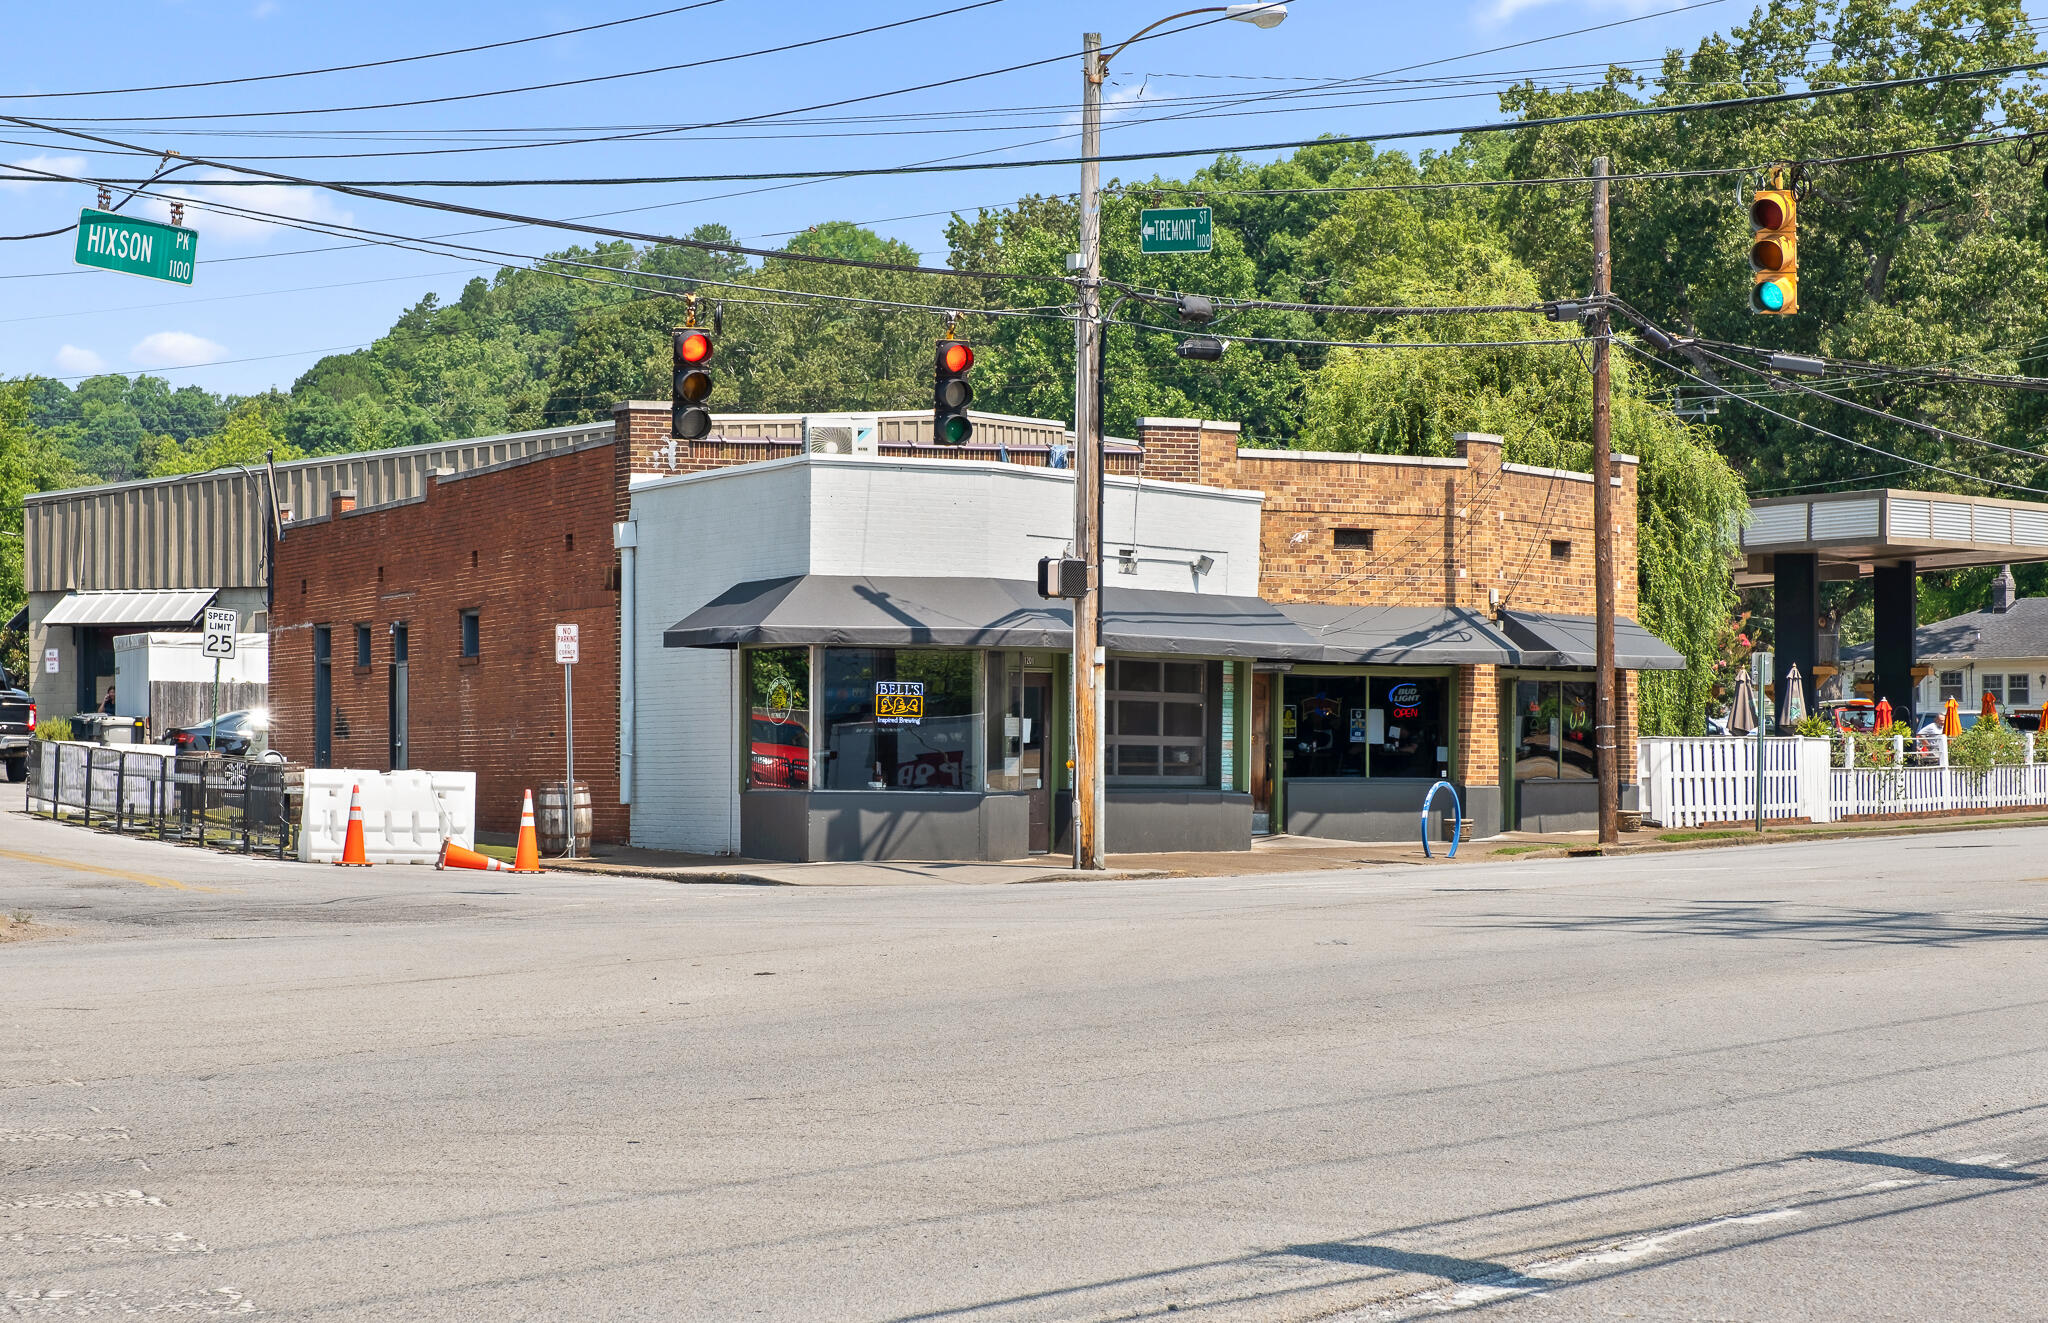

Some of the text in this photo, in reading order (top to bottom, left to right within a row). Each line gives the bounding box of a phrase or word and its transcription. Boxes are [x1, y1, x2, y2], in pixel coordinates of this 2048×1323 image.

[1199, 210, 1207, 224] ST
[1154, 219, 1196, 241] TREMONT
[87, 224, 153, 263] HIXSON
[176, 232, 190, 250] PK
[1197, 233, 1210, 248] 1100
[169, 260, 190, 280] 1100
[208, 611, 235, 622] SPEED
[209, 622, 231, 632] LIMIT
[562, 627, 572, 635] NO
[207, 634, 232, 653] 25
[557, 635, 577, 643] PARKING
[880, 683, 921, 696] BELL'S
[1394, 694, 1420, 702] LIGHT
[1393, 708, 1418, 718] OPEN
[877, 716, 921, 726] Inspired Brewing
